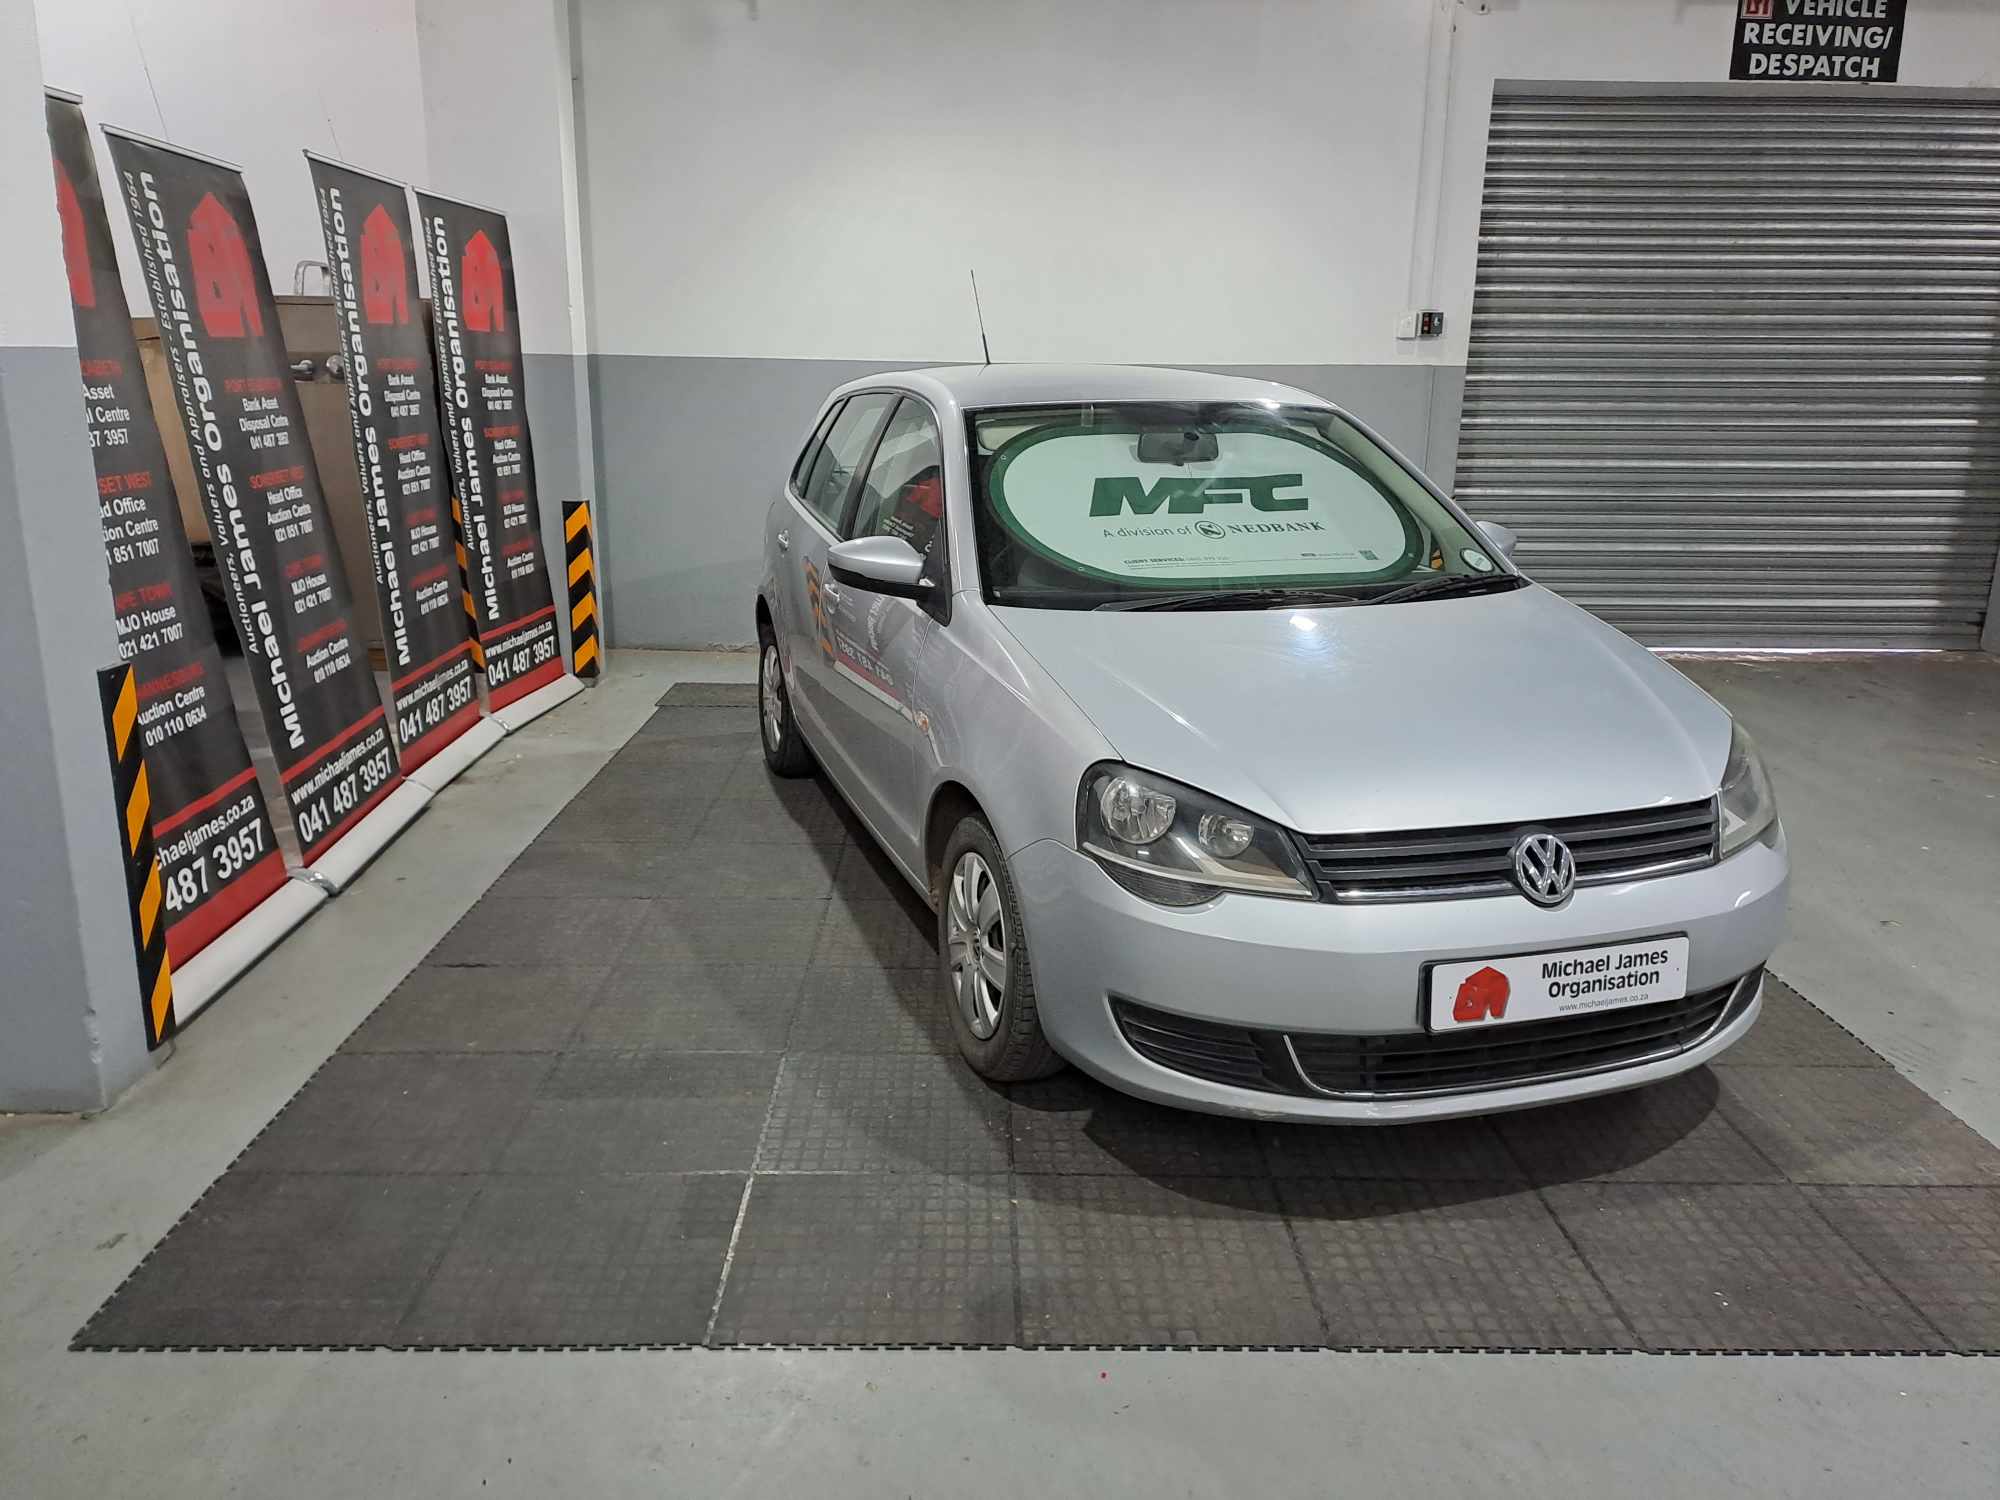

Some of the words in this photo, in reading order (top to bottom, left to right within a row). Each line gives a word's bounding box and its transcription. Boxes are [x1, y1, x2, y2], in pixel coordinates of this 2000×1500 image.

[1786, 0, 1888, 18] VEHICLE
[1743, 22, 1894, 50] RECEIVING/
[1749, 53, 1881, 78] DESPATCH
[139, 225, 172, 330] Established
[140, 170, 222, 451] Organisation
[329, 187, 372, 417] Organisation
[433, 216, 469, 409] Organisation
[95, 406, 131, 422] Centre
[170, 345, 202, 440] Appraisers
[104, 428, 129, 446] 3957
[194, 444, 211, 478] and
[365, 426, 391, 532] James
[460, 416, 483, 507] James
[113, 497, 147, 516] Office
[206, 483, 229, 546] Valuers
[1090, 474, 1309, 517] MFC
[125, 518, 159, 537] Centre
[216, 463, 261, 590] James
[1103, 527, 1114, 538] A
[1117, 526, 1170, 538] division
[1173, 525, 1192, 536] of
[1227, 520, 1326, 536] NEDBANK
[113, 544, 134, 563] 851
[136, 538, 160, 557] 7007
[473, 514, 500, 620] Michael
[141, 606, 176, 627] House
[380, 541, 410, 666] Michael
[119, 639, 139, 659] 021
[140, 631, 160, 652] 421
[160, 623, 183, 644] 7007
[487, 658, 510, 687] 041
[512, 649, 530, 675] 487
[532, 635, 555, 665] 3957
[175, 685, 205, 709] Centre
[251, 601, 305, 749] Michael
[145, 725, 164, 747] 010
[164, 715, 185, 737] 110
[185, 705, 208, 729] 0634
[400, 711, 424, 744] 041
[425, 694, 446, 727] 487
[447, 675, 473, 709] 3957
[291, 727, 384, 805] www.michaeljames.co.za
[299, 797, 330, 842] 041
[333, 773, 359, 815] 487
[360, 747, 391, 792] 3957
[165, 856, 208, 912] 487
[212, 818, 263, 880] 3957
[1541, 956, 1611, 979] Michael
[1614, 950, 1669, 972] James
[1548, 970, 1660, 999] Organisation
